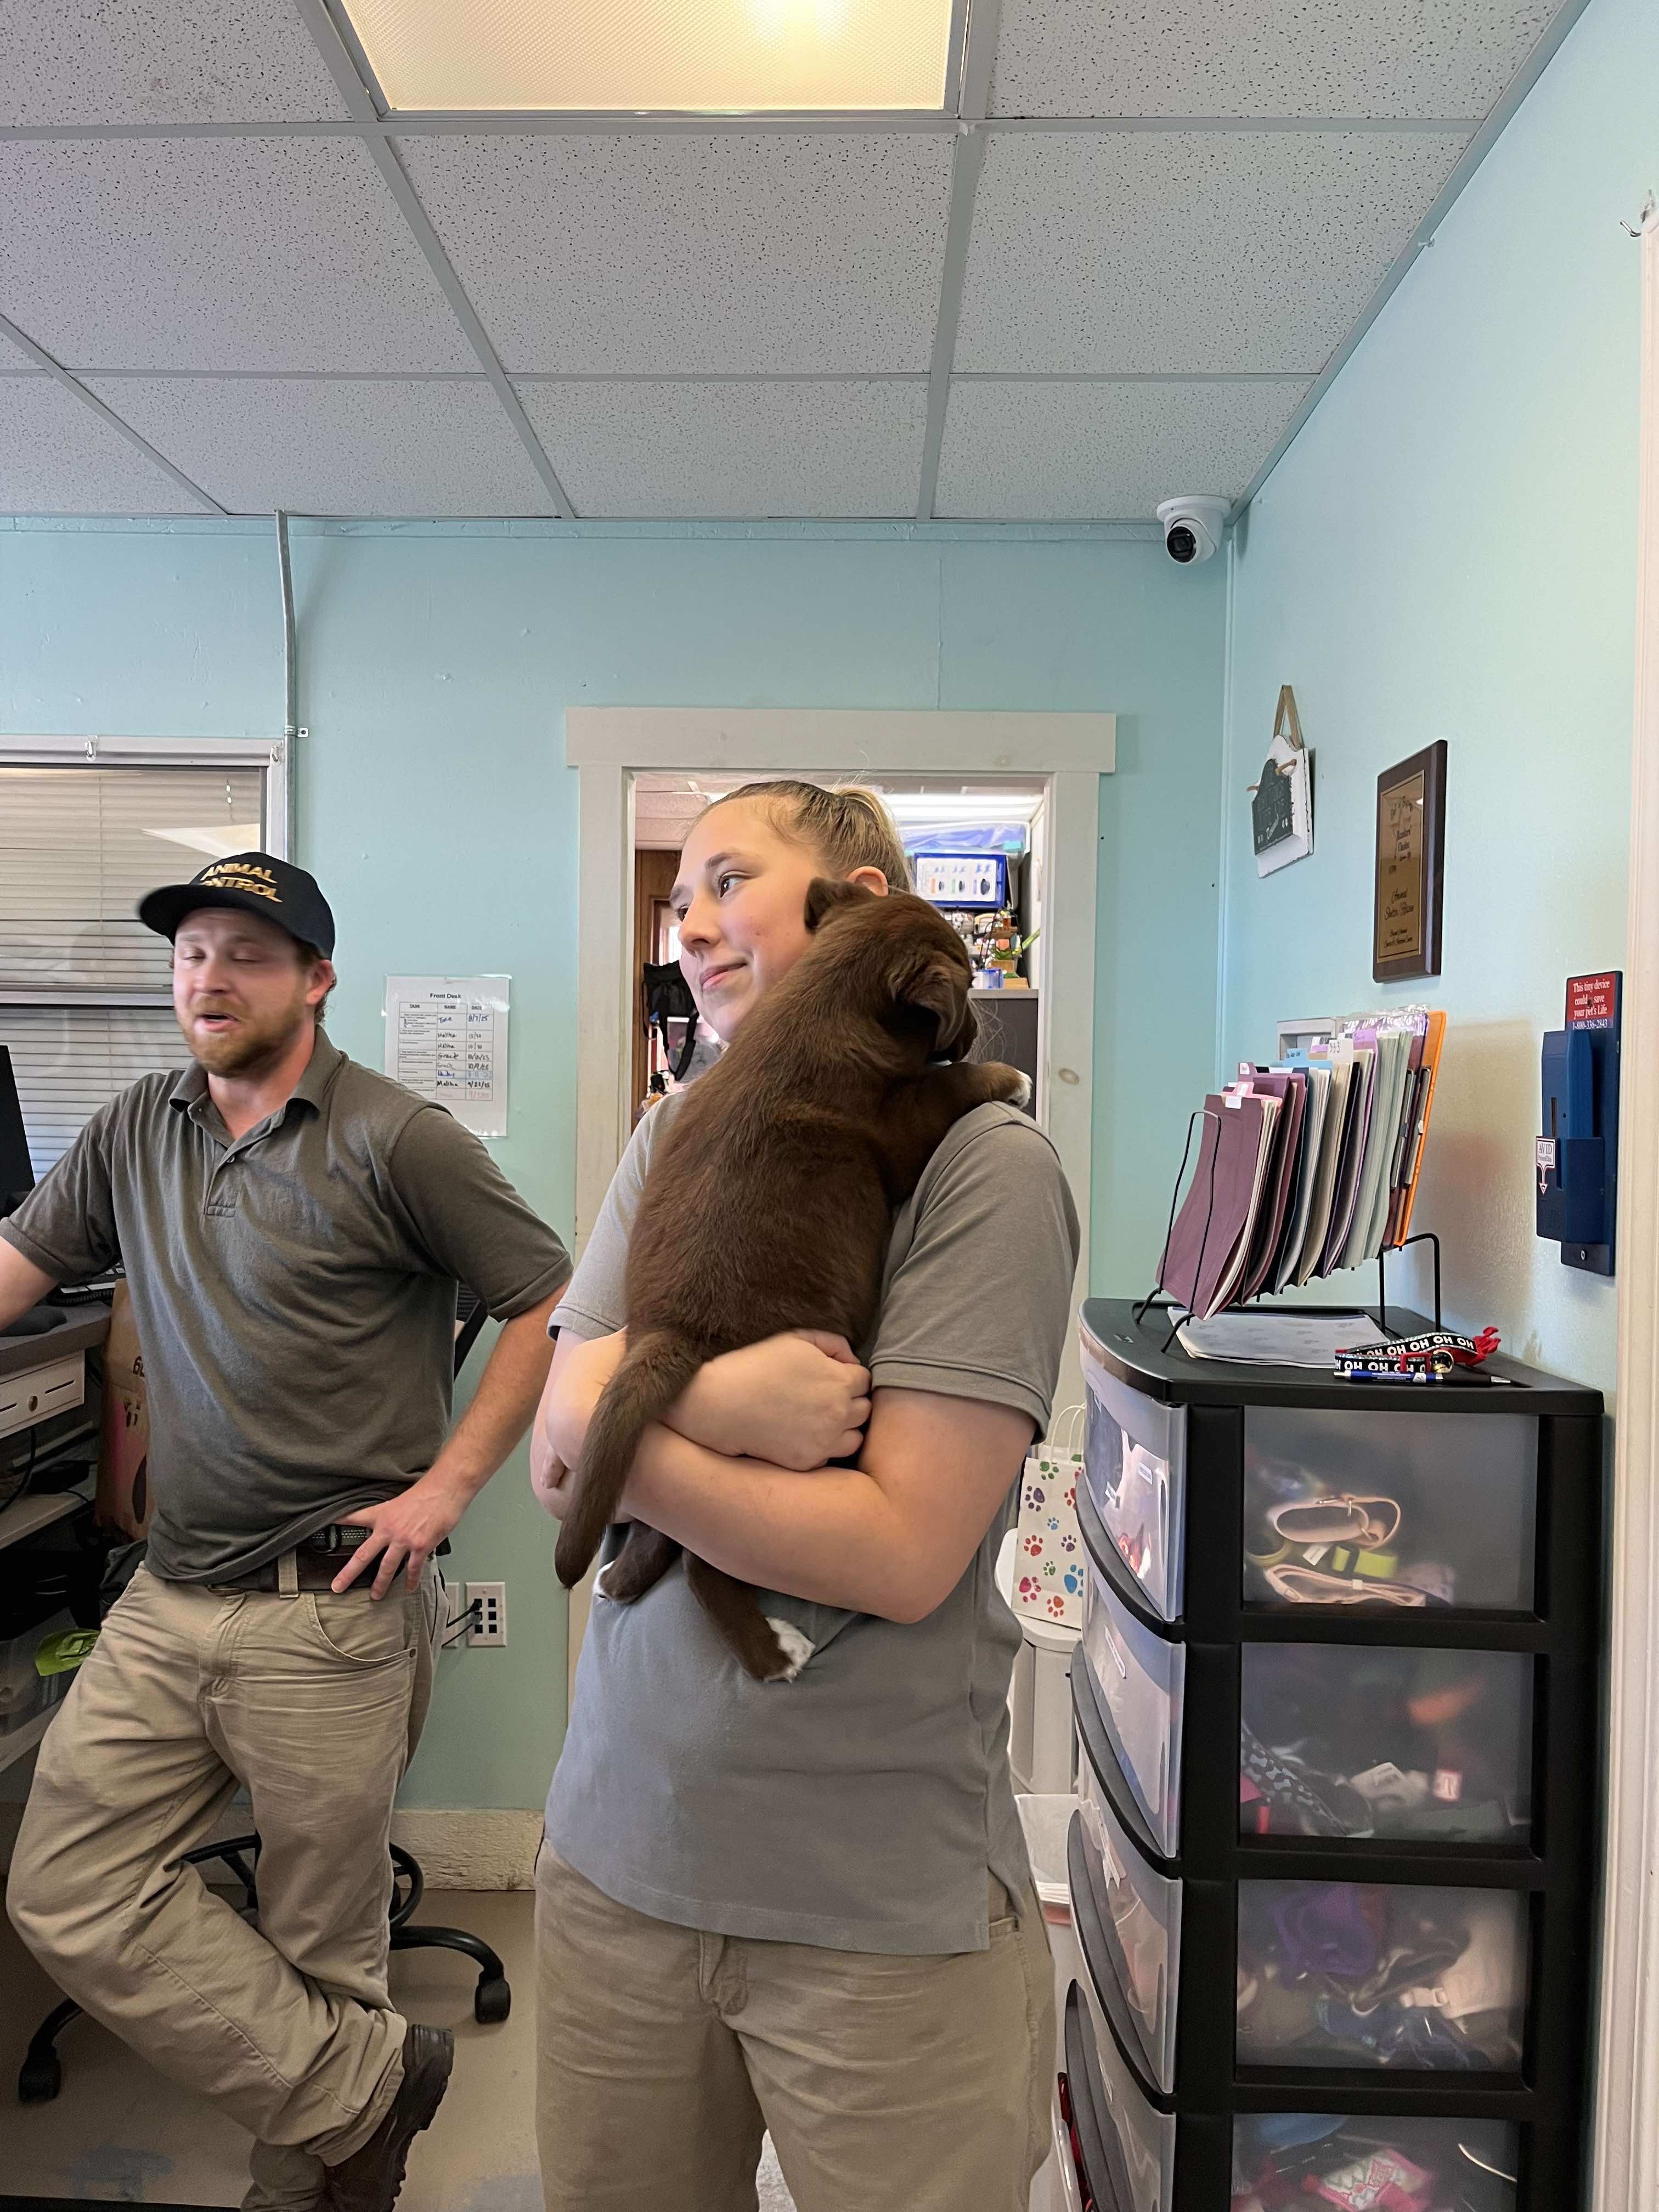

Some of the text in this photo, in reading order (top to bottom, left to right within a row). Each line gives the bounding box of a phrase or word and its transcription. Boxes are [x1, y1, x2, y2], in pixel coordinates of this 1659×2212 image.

[200, 863, 278, 883] ANIMAL
[201, 876, 283, 903] ONTROL
[1573, 979, 1610, 992] This tiny device
[1575, 994, 1605, 1005] could save
[1573, 1004, 1607, 1020] your pet's Life
[1538, 1143, 1553, 1154] AVID
[1387, 1344, 1406, 1355] OH
[1410, 1339, 1429, 1351] OH
[1433, 1335, 1453, 1346] OH
[1457, 1338, 1474, 1350] OH
[1344, 1361, 1362, 1370] OH
[1368, 1362, 1389, 1372] OH
